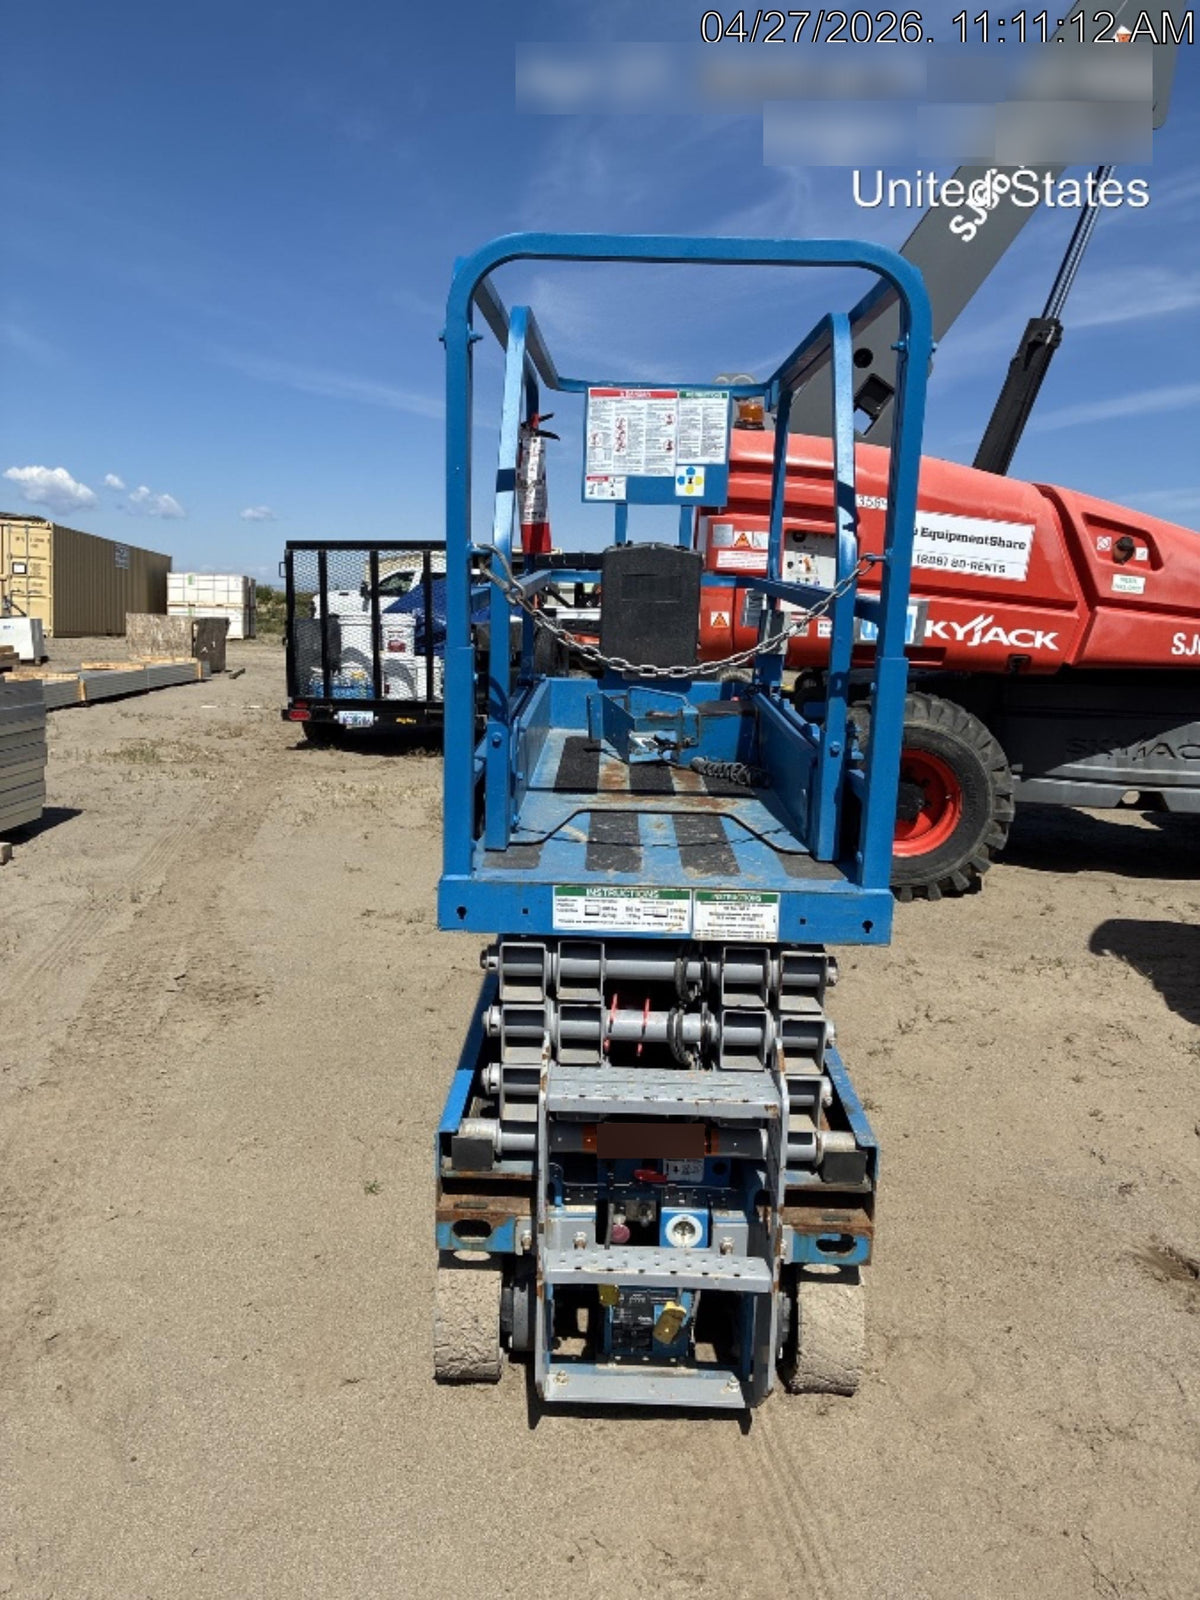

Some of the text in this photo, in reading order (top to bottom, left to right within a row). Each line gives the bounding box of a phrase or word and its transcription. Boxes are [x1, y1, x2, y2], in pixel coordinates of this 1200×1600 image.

[920, 527, 1027, 551] EquipmentShare
[924, 613, 1059, 651] KYJACK
[1171, 632, 1200, 656] SJ
[586, 887, 660, 899] INSTRUCTIONS
